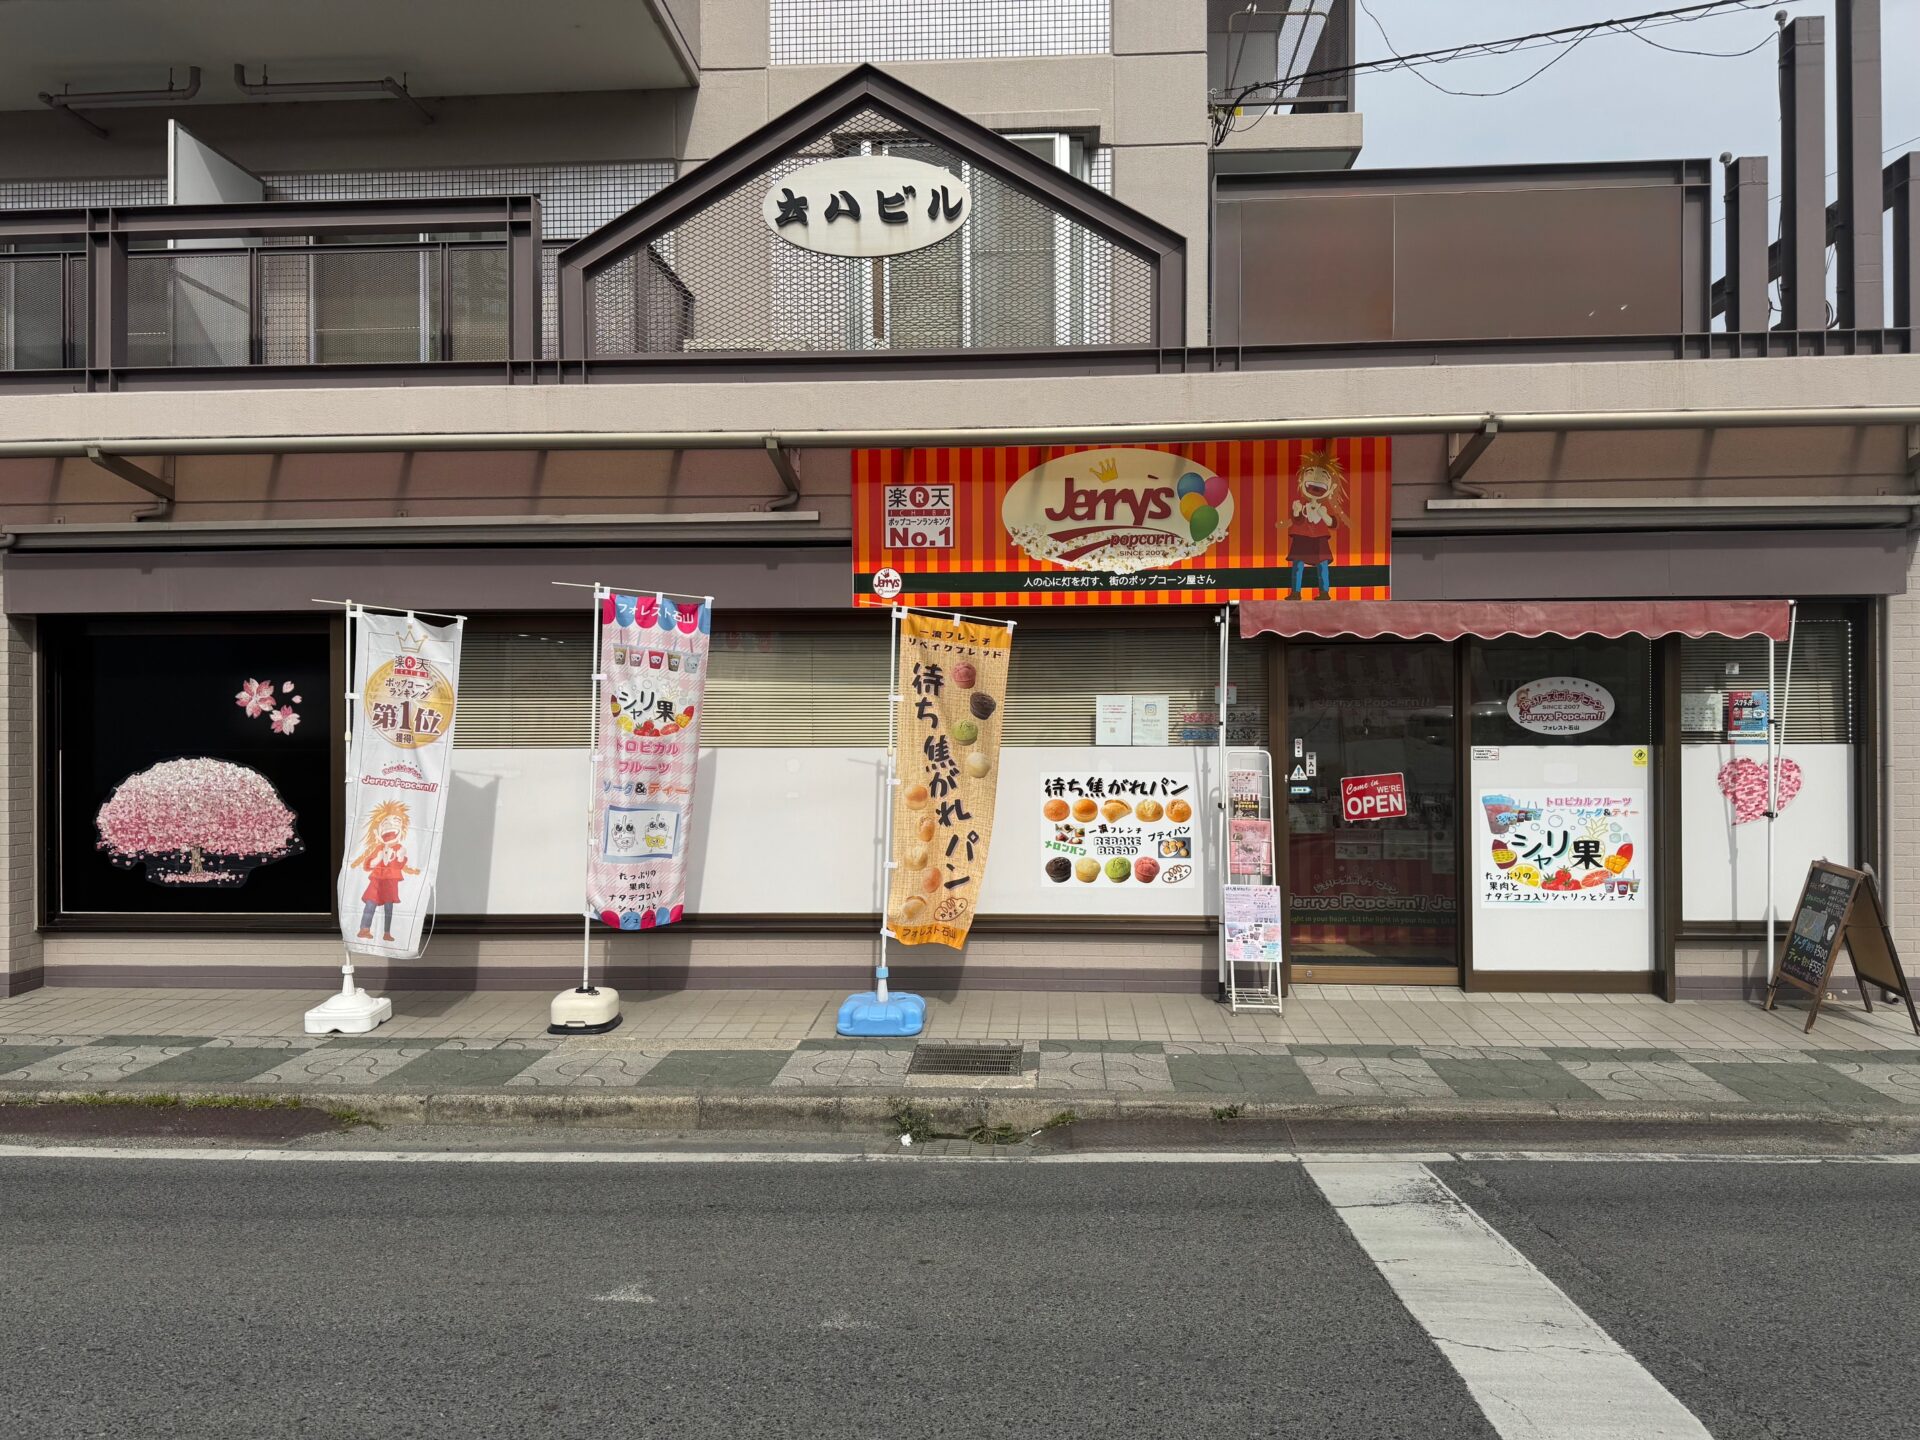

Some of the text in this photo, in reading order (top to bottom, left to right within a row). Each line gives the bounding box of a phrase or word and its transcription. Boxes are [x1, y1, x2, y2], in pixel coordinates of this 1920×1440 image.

[888, 517, 951, 526] ポップコーンランキング
[889, 526, 951, 547] No.1
[1109, 533, 1176, 547] popcorn
[617, 603, 695, 624] フォレスト石山
[909, 637, 1002, 658] リベイクブレッド
[385, 678, 435, 691] ポップコーン
[389, 687, 431, 700] ランキング
[371, 700, 444, 735] 第1位
[1519, 711, 1606, 722] Jerrys Popcorn!!
[618, 760, 671, 774] フルーツ
[362, 774, 395, 789] Jerrys
[911, 662, 979, 889] 待ち焦がれパン
[1044, 776, 1190, 798] 待ち焦がれパン
[1346, 779, 1380, 795] Come in
[1376, 784, 1402, 794] WE'RE
[1346, 793, 1404, 816] OPEN
[1094, 836, 1141, 846] REBAKE
[1044, 840, 1087, 857] メロンパン
[1097, 846, 1138, 855] BREAD
[619, 869, 656, 881] たっぷりの
[1485, 871, 1532, 881] たっぷりの
[629, 882, 651, 891] 果肉と
[1489, 882, 1519, 891] 果肉と
[609, 889, 663, 901] ナタデココ入り
[902, 926, 956, 939] フォレスト石山
